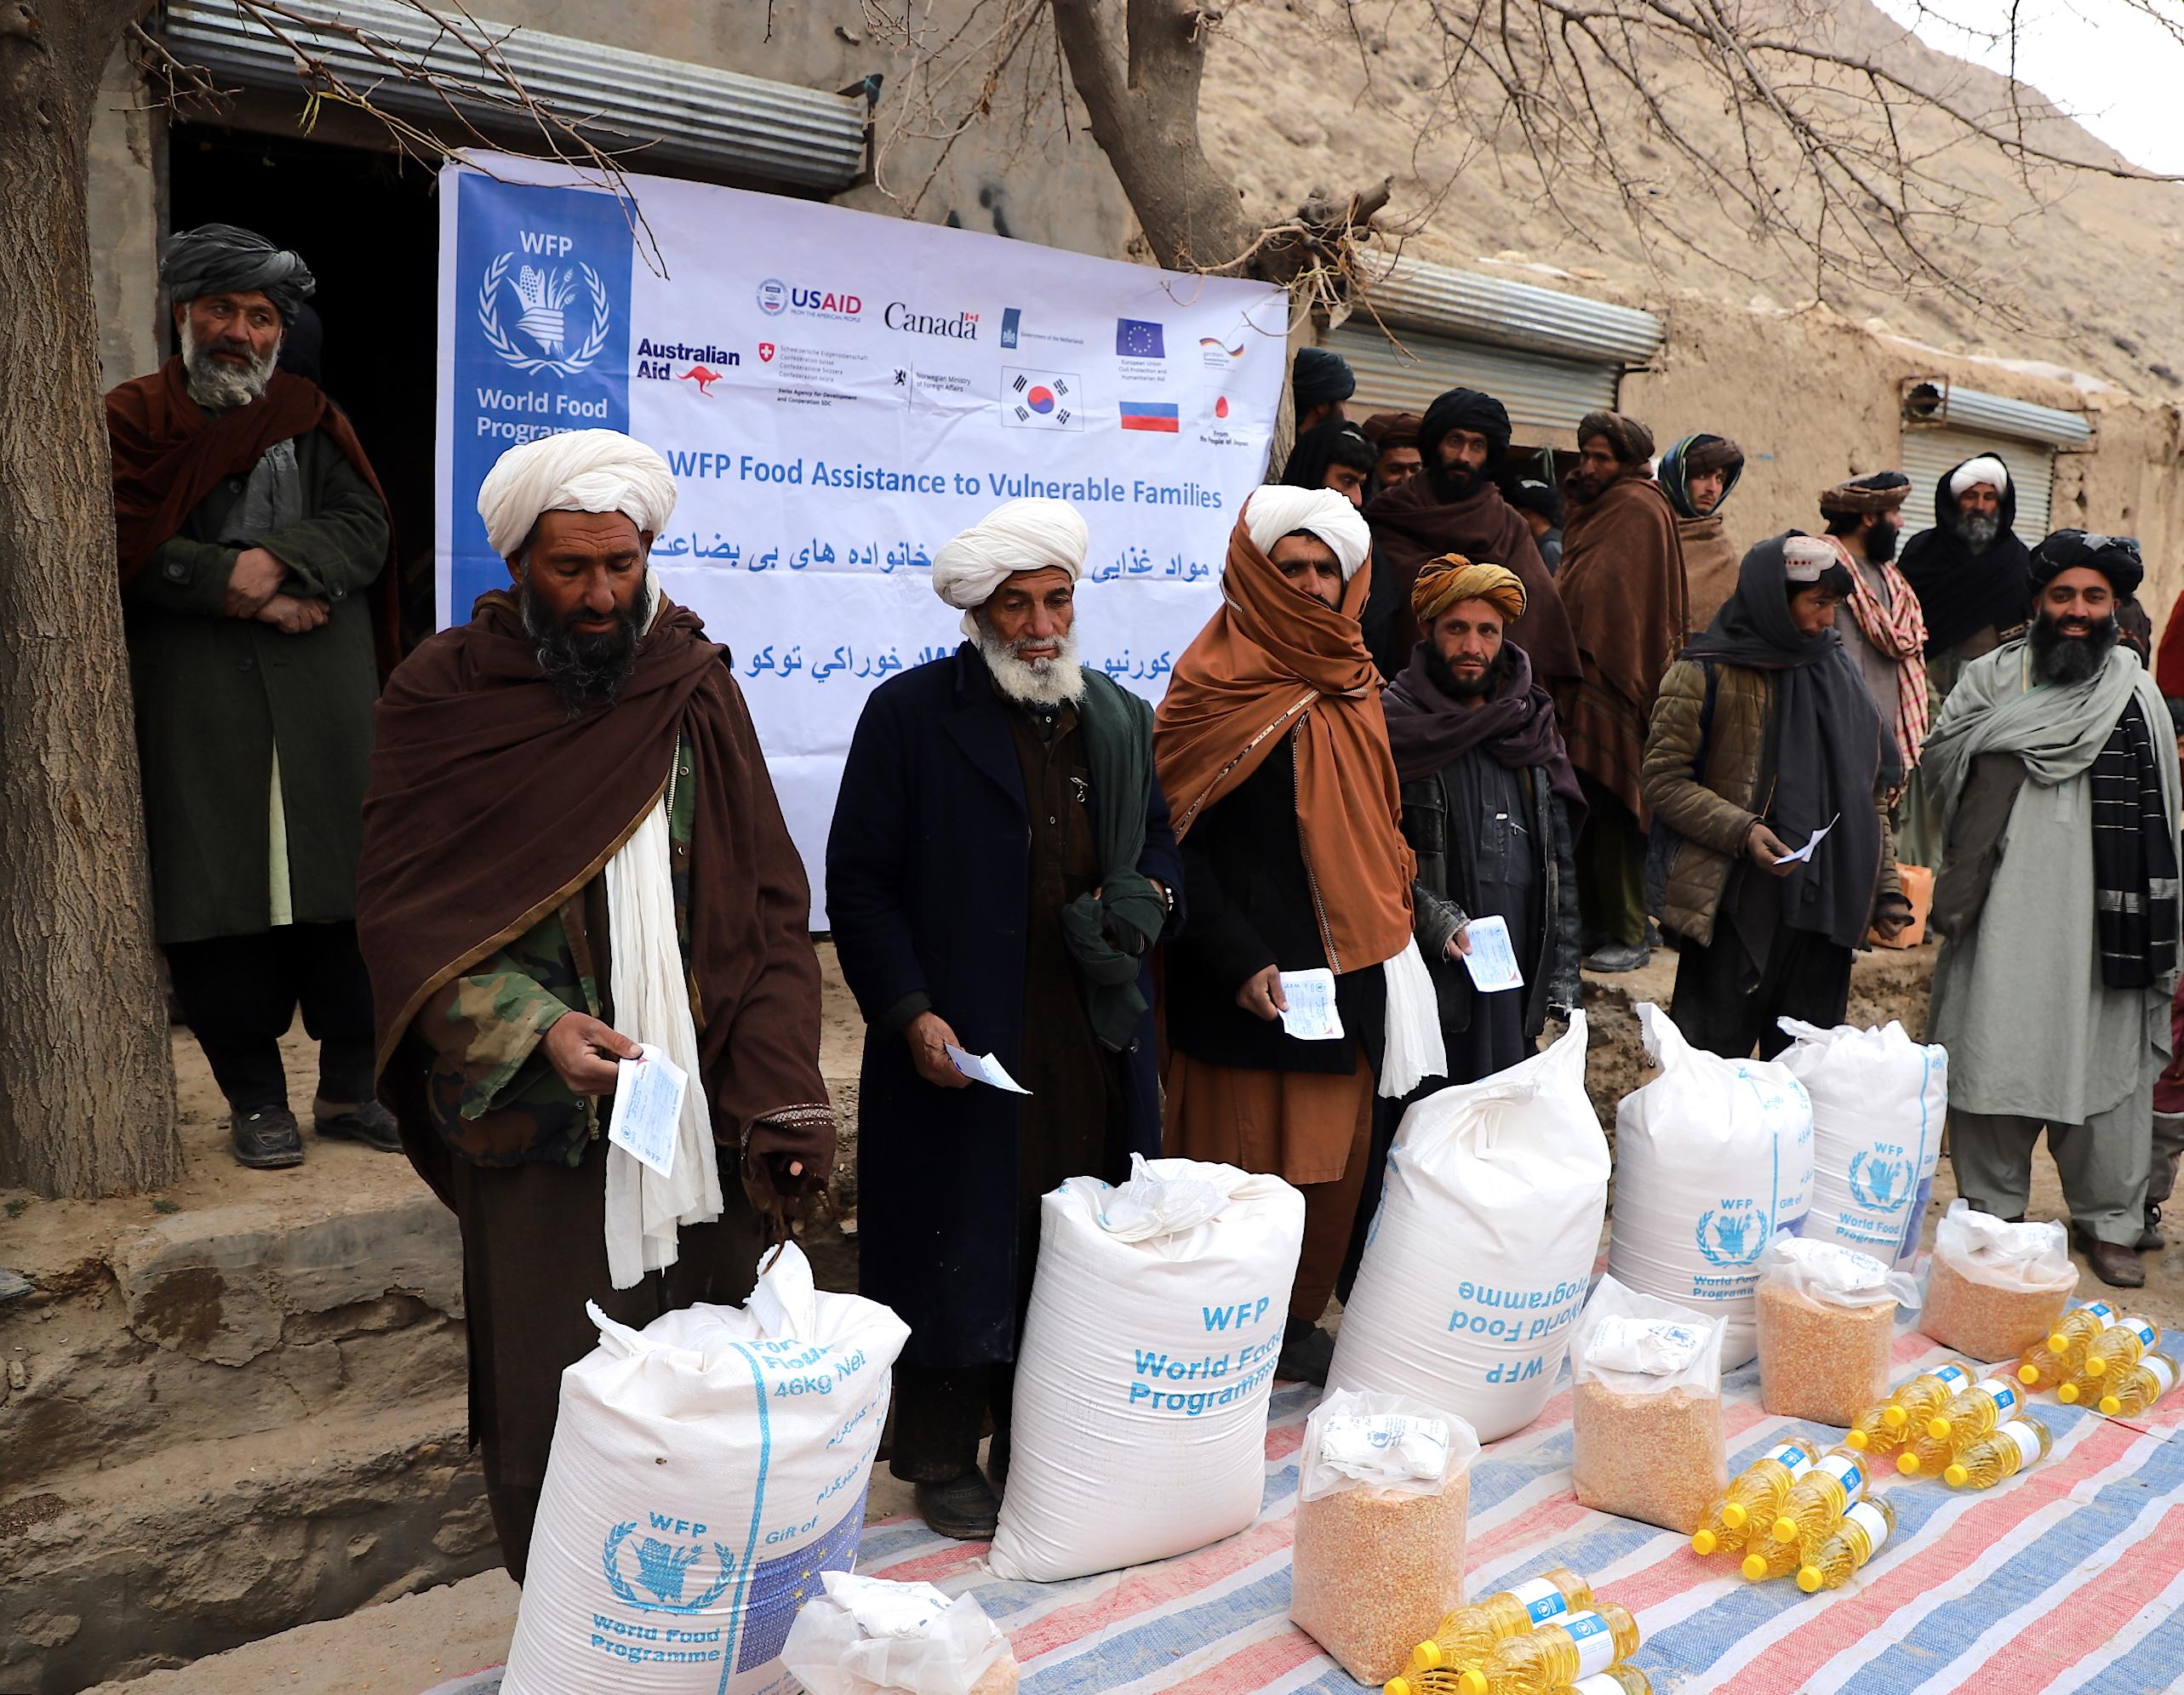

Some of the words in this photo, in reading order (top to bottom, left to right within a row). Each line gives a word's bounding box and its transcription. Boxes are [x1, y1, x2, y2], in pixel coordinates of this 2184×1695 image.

[519, 231, 573, 258] WFP
[792, 288, 861, 314] USAID
[884, 301, 978, 340] Canada
[637, 339, 740, 366] Australian
[637, 361, 671, 380] Aid
[477, 388, 548, 414] World
[557, 395, 608, 419] Food
[477, 417, 582, 445] Progra
[667, 450, 730, 478] WFP
[740, 456, 803, 484] Food
[812, 461, 946, 494] Assistance
[953, 473, 981, 496] to
[988, 473, 1124, 501] Vulnerable
[1134, 480, 1222, 509] Families
[650, 532, 740, 568] بضاعت
[748, 545, 778, 573] بی
[789, 538, 835, 569] های
[849, 540, 932, 574] خانواده
[1166, 553, 1209, 582] مواد
[1874, 1142, 1904, 1157] WFP
[1721, 1199, 1753, 1209] WFP
[1780, 1197, 1794, 1209] Gift
[1836, 1226, 1899, 1247] Programme
[1839, 1213, 1873, 1230] World
[1876, 1222, 1900, 1234] Food
[1694, 1275, 1732, 1286] World
[1203, 1297, 1270, 1332] WFP
[1448, 1310, 1523, 1342] Food
[775, 1375, 832, 1397] 46kg
[834, 1349, 866, 1382] Net
[1135, 1349, 1230, 1380] World
[1485, 1356, 1543, 1384] WFP
[649, 1511, 707, 1538] WFP
[765, 1525, 798, 1544] Gift
[801, 1515, 818, 1533] of
[592, 1613, 657, 1641] World
[666, 1627, 721, 1643] Food
[591, 1634, 722, 1664] Programme
